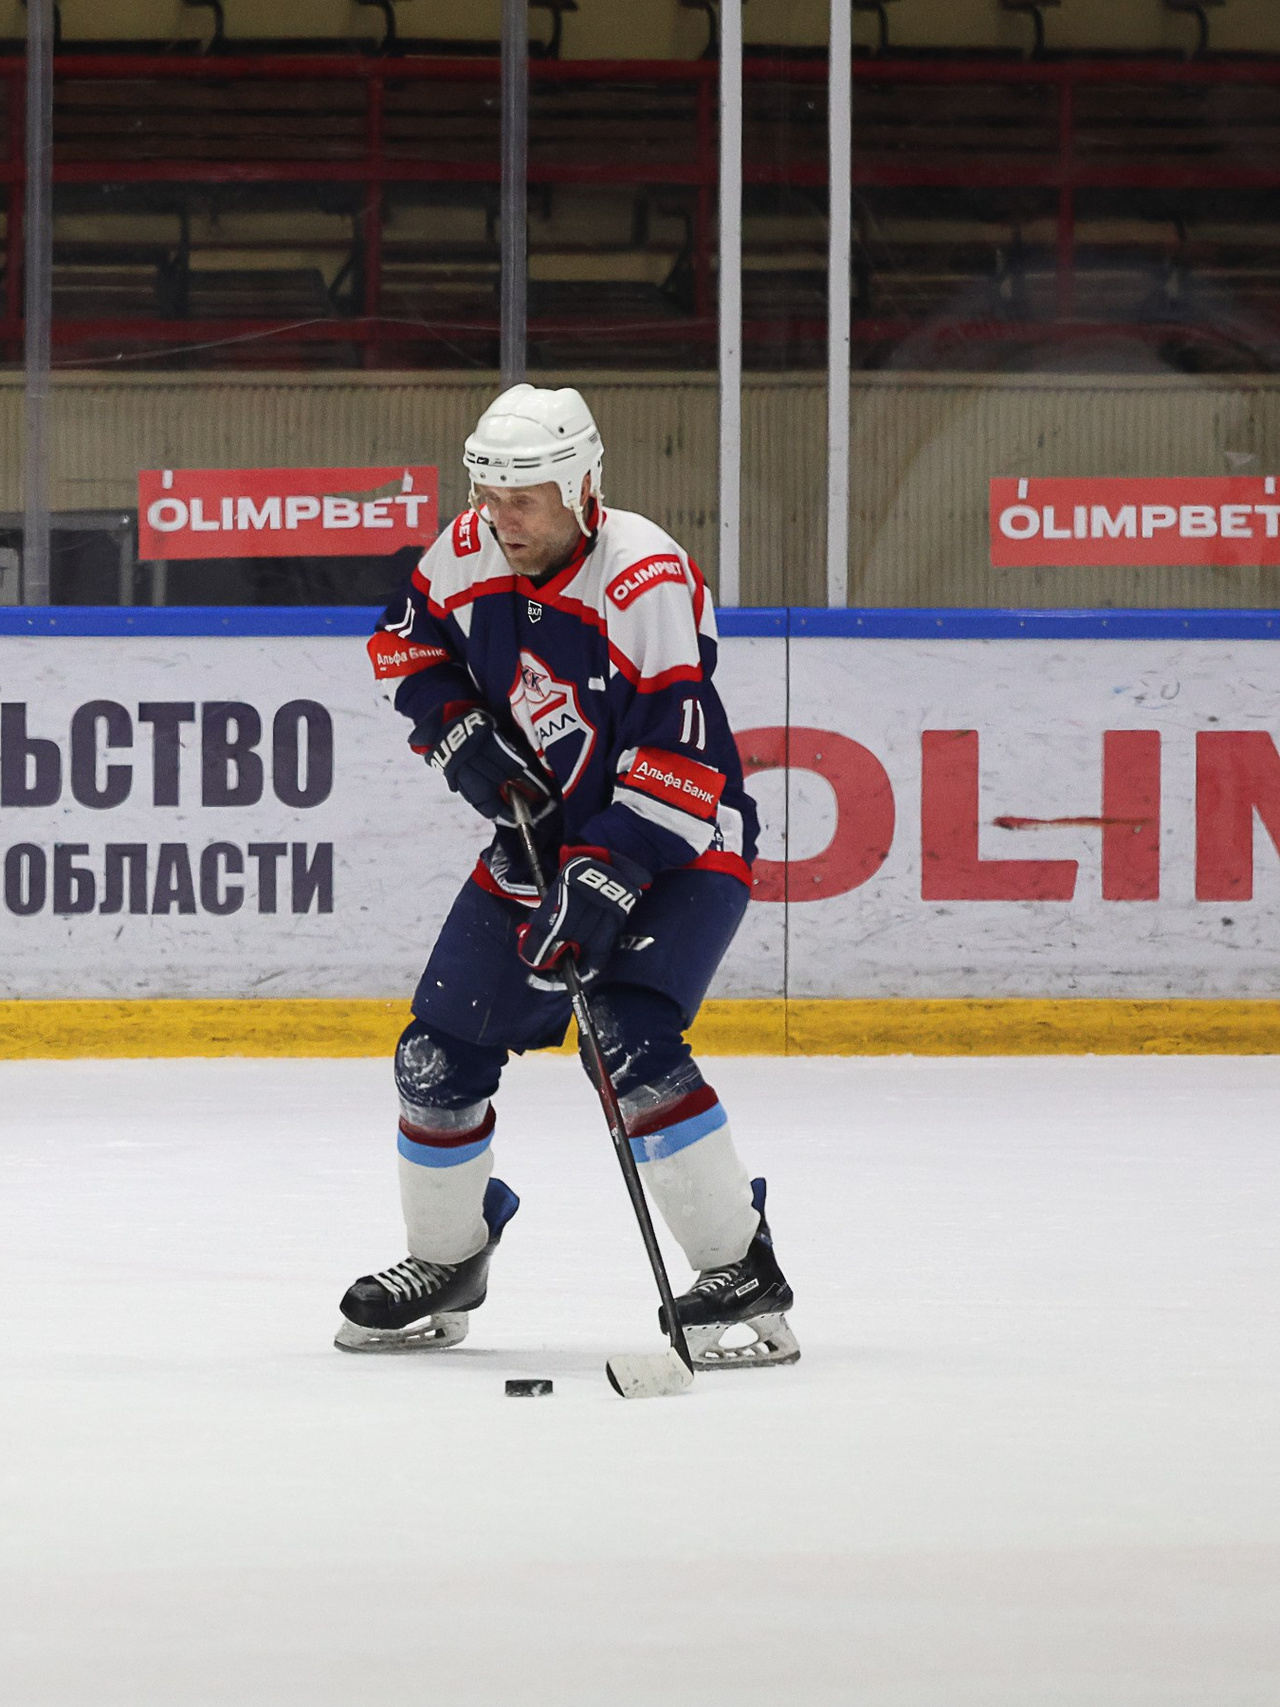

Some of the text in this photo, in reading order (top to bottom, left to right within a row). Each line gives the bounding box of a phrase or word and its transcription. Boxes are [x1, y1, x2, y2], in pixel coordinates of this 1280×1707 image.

[147, 495, 429, 531] OLIMPBET
[999, 505, 1280, 539] OLIMPBET
[376, 647, 444, 671] Альфа Банк
[679, 698, 706, 751] 11
[633, 761, 715, 805] Альфа Банк
[4, 842, 334, 917] ОБЛАСТИ
